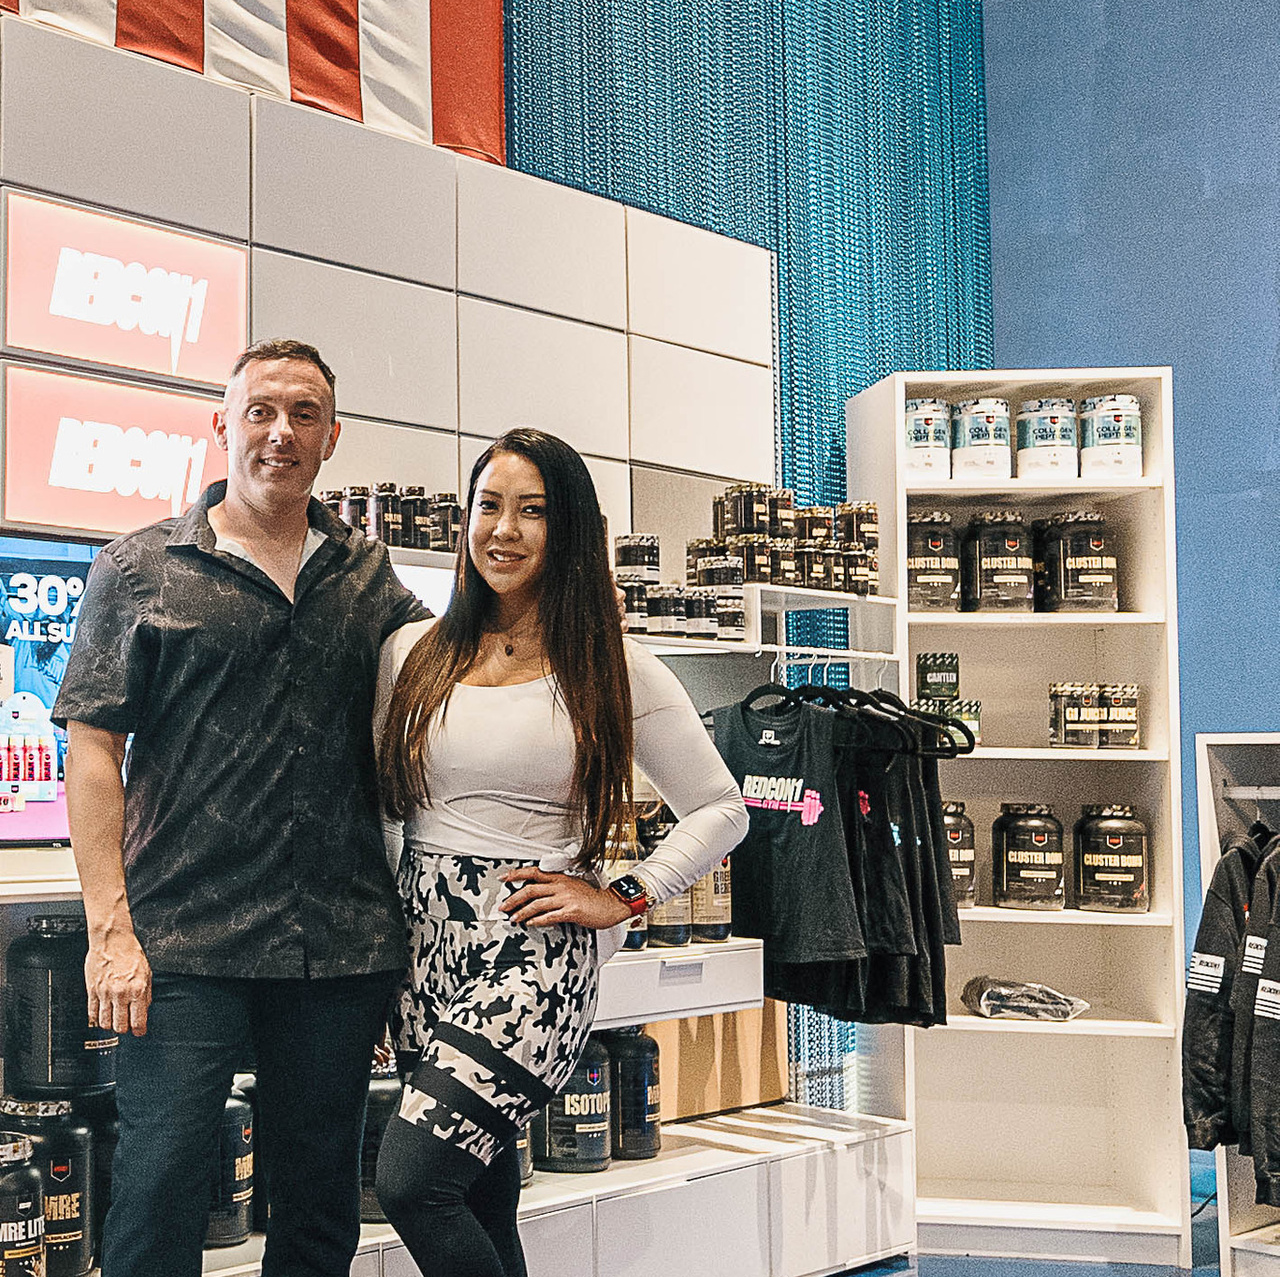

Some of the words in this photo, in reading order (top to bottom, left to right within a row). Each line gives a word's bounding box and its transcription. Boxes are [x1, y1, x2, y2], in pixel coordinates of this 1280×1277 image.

[981, 556, 1015, 569] CLUSTER
[1066, 556, 1102, 570] CLUSTER
[5, 620, 47, 642] ALL
[47, 622, 76, 644] SU
[743, 775, 804, 813] REDCON1
[1008, 851, 1045, 864] CLUSTER
[1084, 854, 1120, 867] CLUSTER
